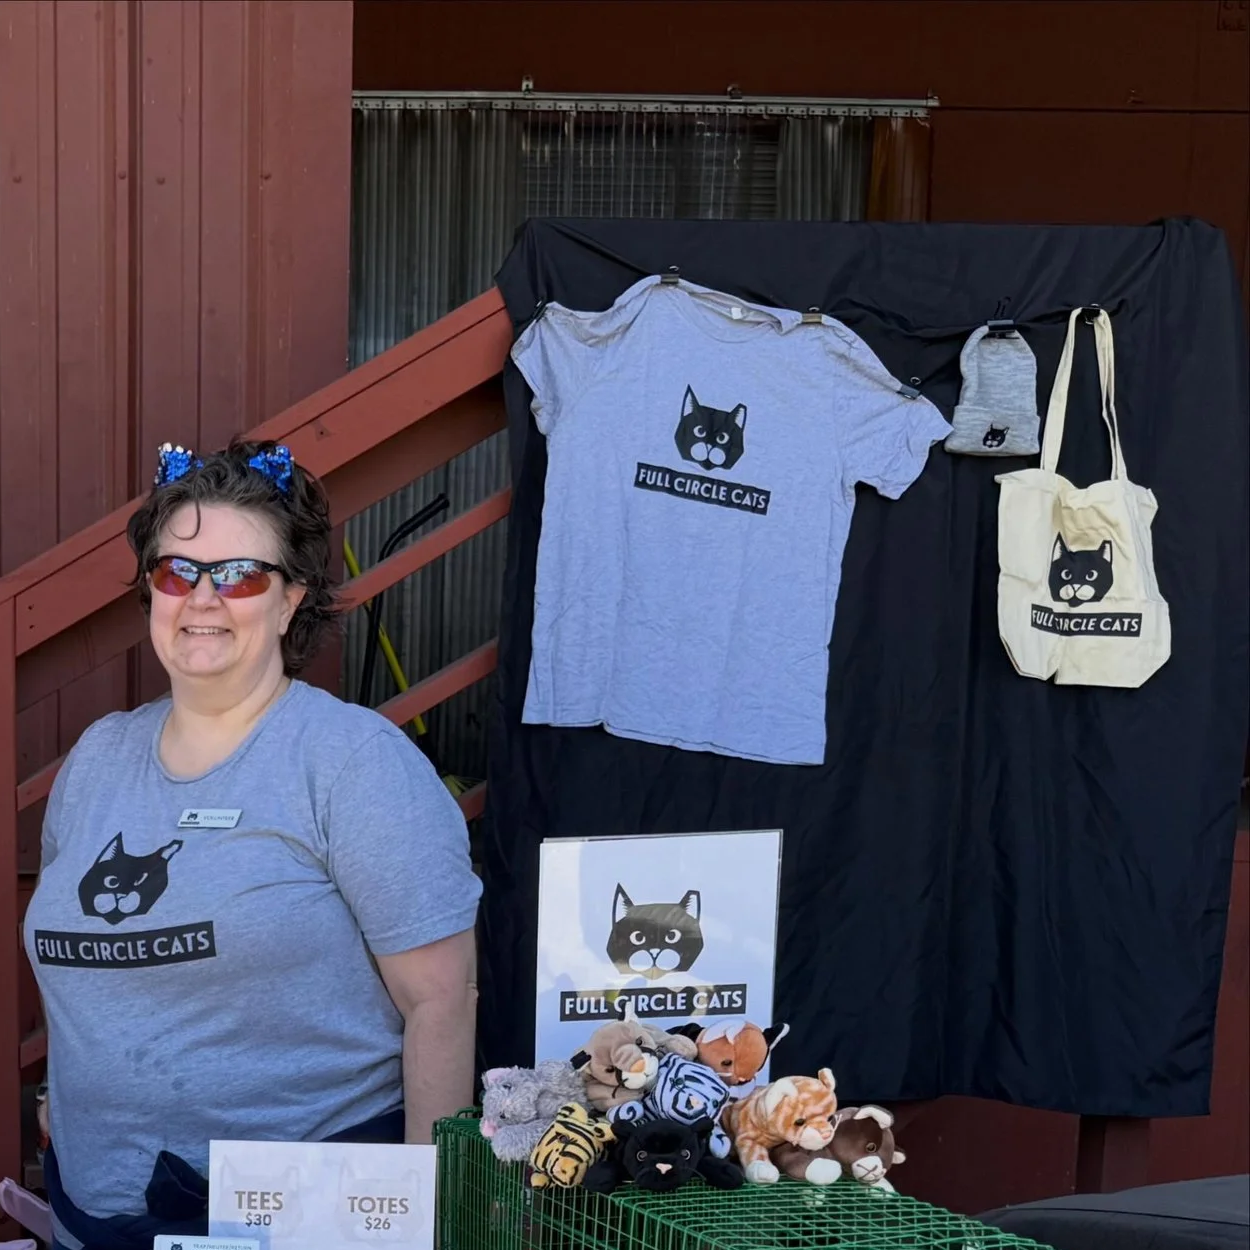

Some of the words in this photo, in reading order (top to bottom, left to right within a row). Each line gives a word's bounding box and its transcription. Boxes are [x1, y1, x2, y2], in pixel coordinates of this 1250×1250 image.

[638, 468, 671, 488] FULL
[673, 477, 728, 501] CIRCLE
[731, 489, 767, 509] CATS
[1032, 609, 1054, 627] FULL
[1099, 617, 1139, 632] CATS
[36, 937, 76, 961] FULL
[78, 939, 149, 962] CIRCLE
[152, 929, 211, 958] CATS
[564, 997, 609, 1016] FULL
[613, 993, 688, 1014] CIRCLE
[692, 990, 744, 1010] CATS
[234, 1190, 284, 1212] TEES
[347, 1195, 410, 1215] TOTES
[245, 1213, 272, 1227] $30
[365, 1216, 392, 1231] $26
